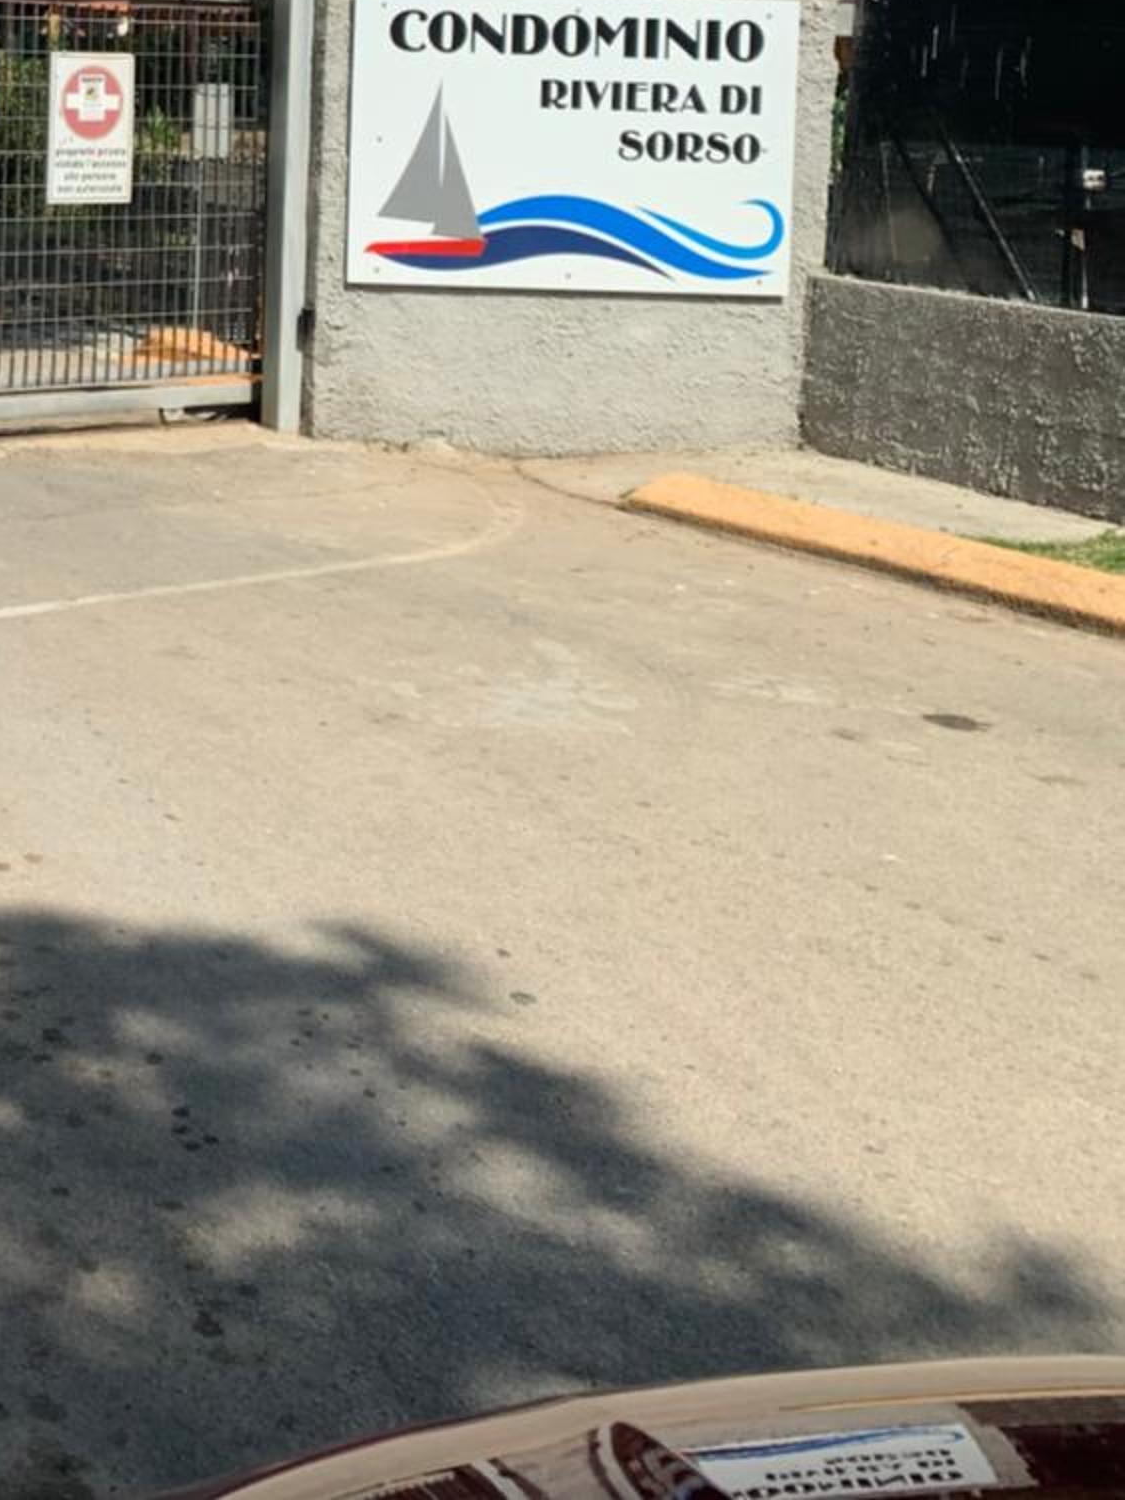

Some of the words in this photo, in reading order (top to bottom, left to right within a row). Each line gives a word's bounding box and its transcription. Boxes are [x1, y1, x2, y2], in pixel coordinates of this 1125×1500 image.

[389, 9, 765, 62] CONDOMINIO
[540, 78, 708, 114] RIVIERA
[720, 84, 763, 116] DI
[618, 130, 763, 165] SORSO
